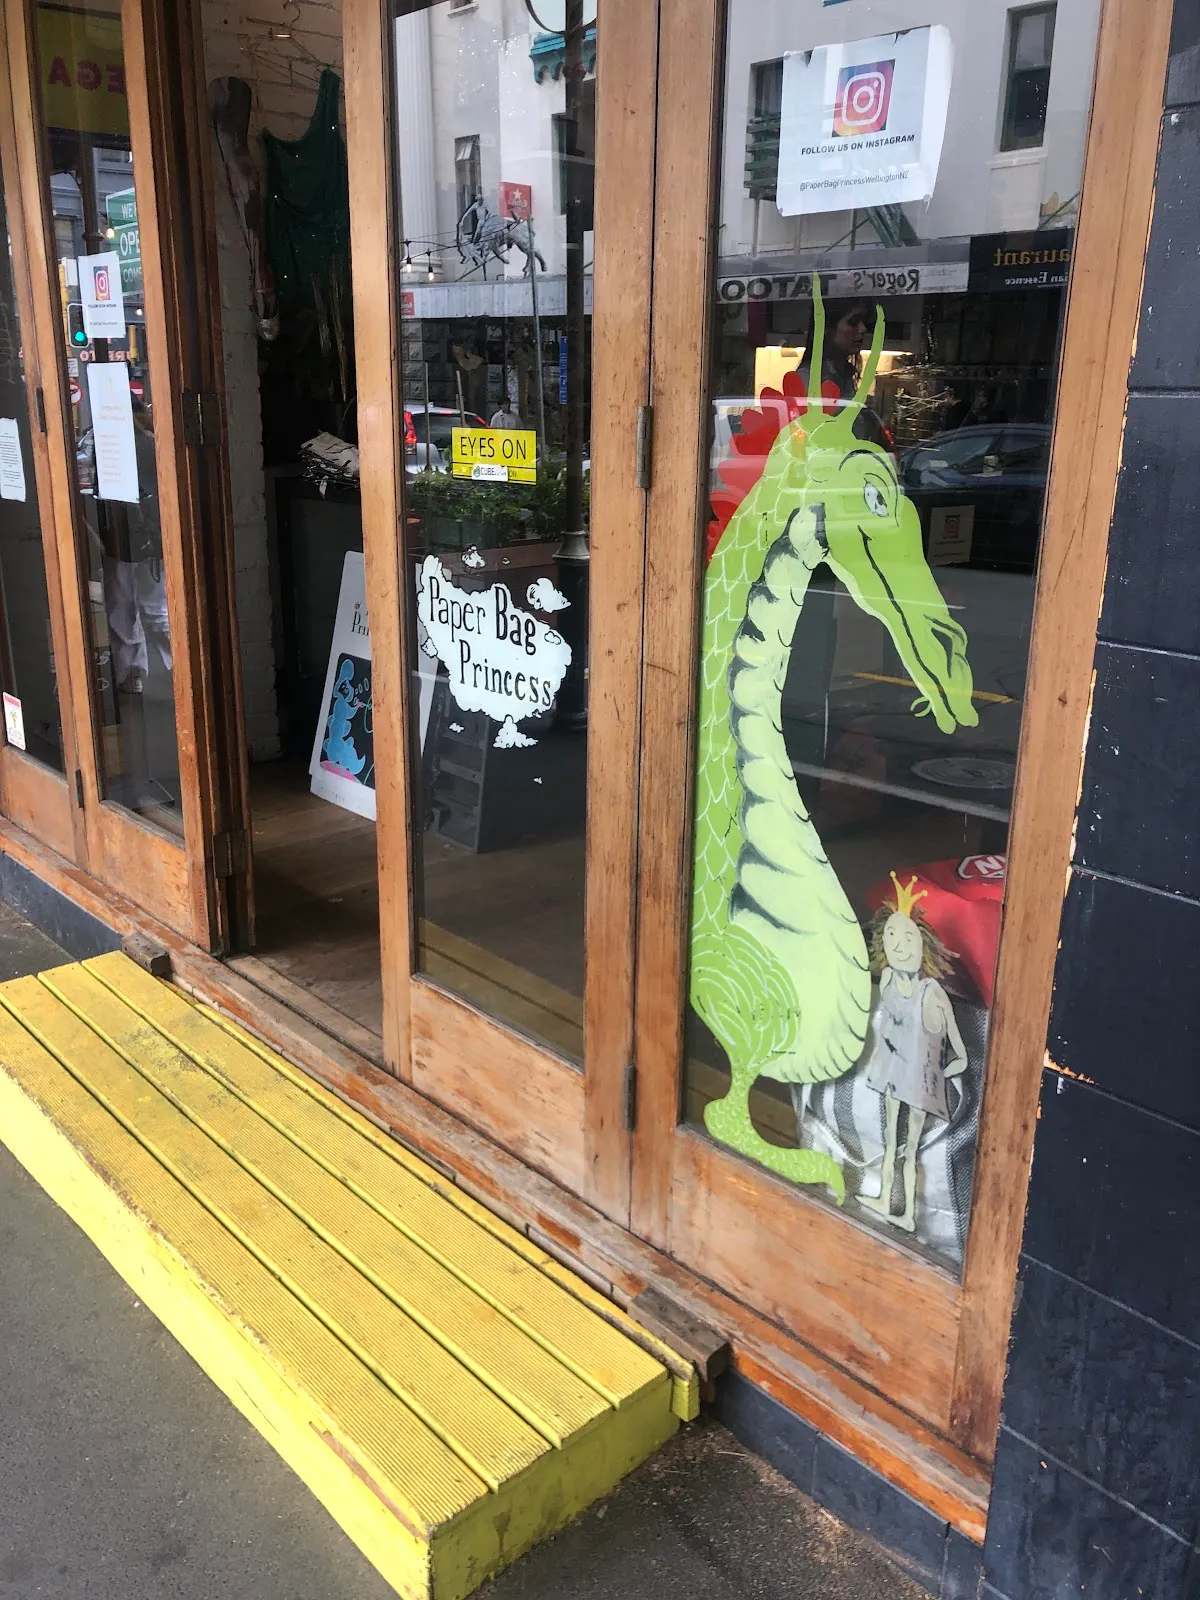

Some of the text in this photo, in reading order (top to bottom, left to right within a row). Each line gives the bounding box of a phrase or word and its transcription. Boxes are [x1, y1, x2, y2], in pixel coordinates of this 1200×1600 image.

[801, 134, 915, 155] FOLLOW US ON INSTAGRAM
[460, 436, 526, 460] EYES ON
[429, 576, 537, 656] Paper Bag
[459, 639, 551, 707] Princess
